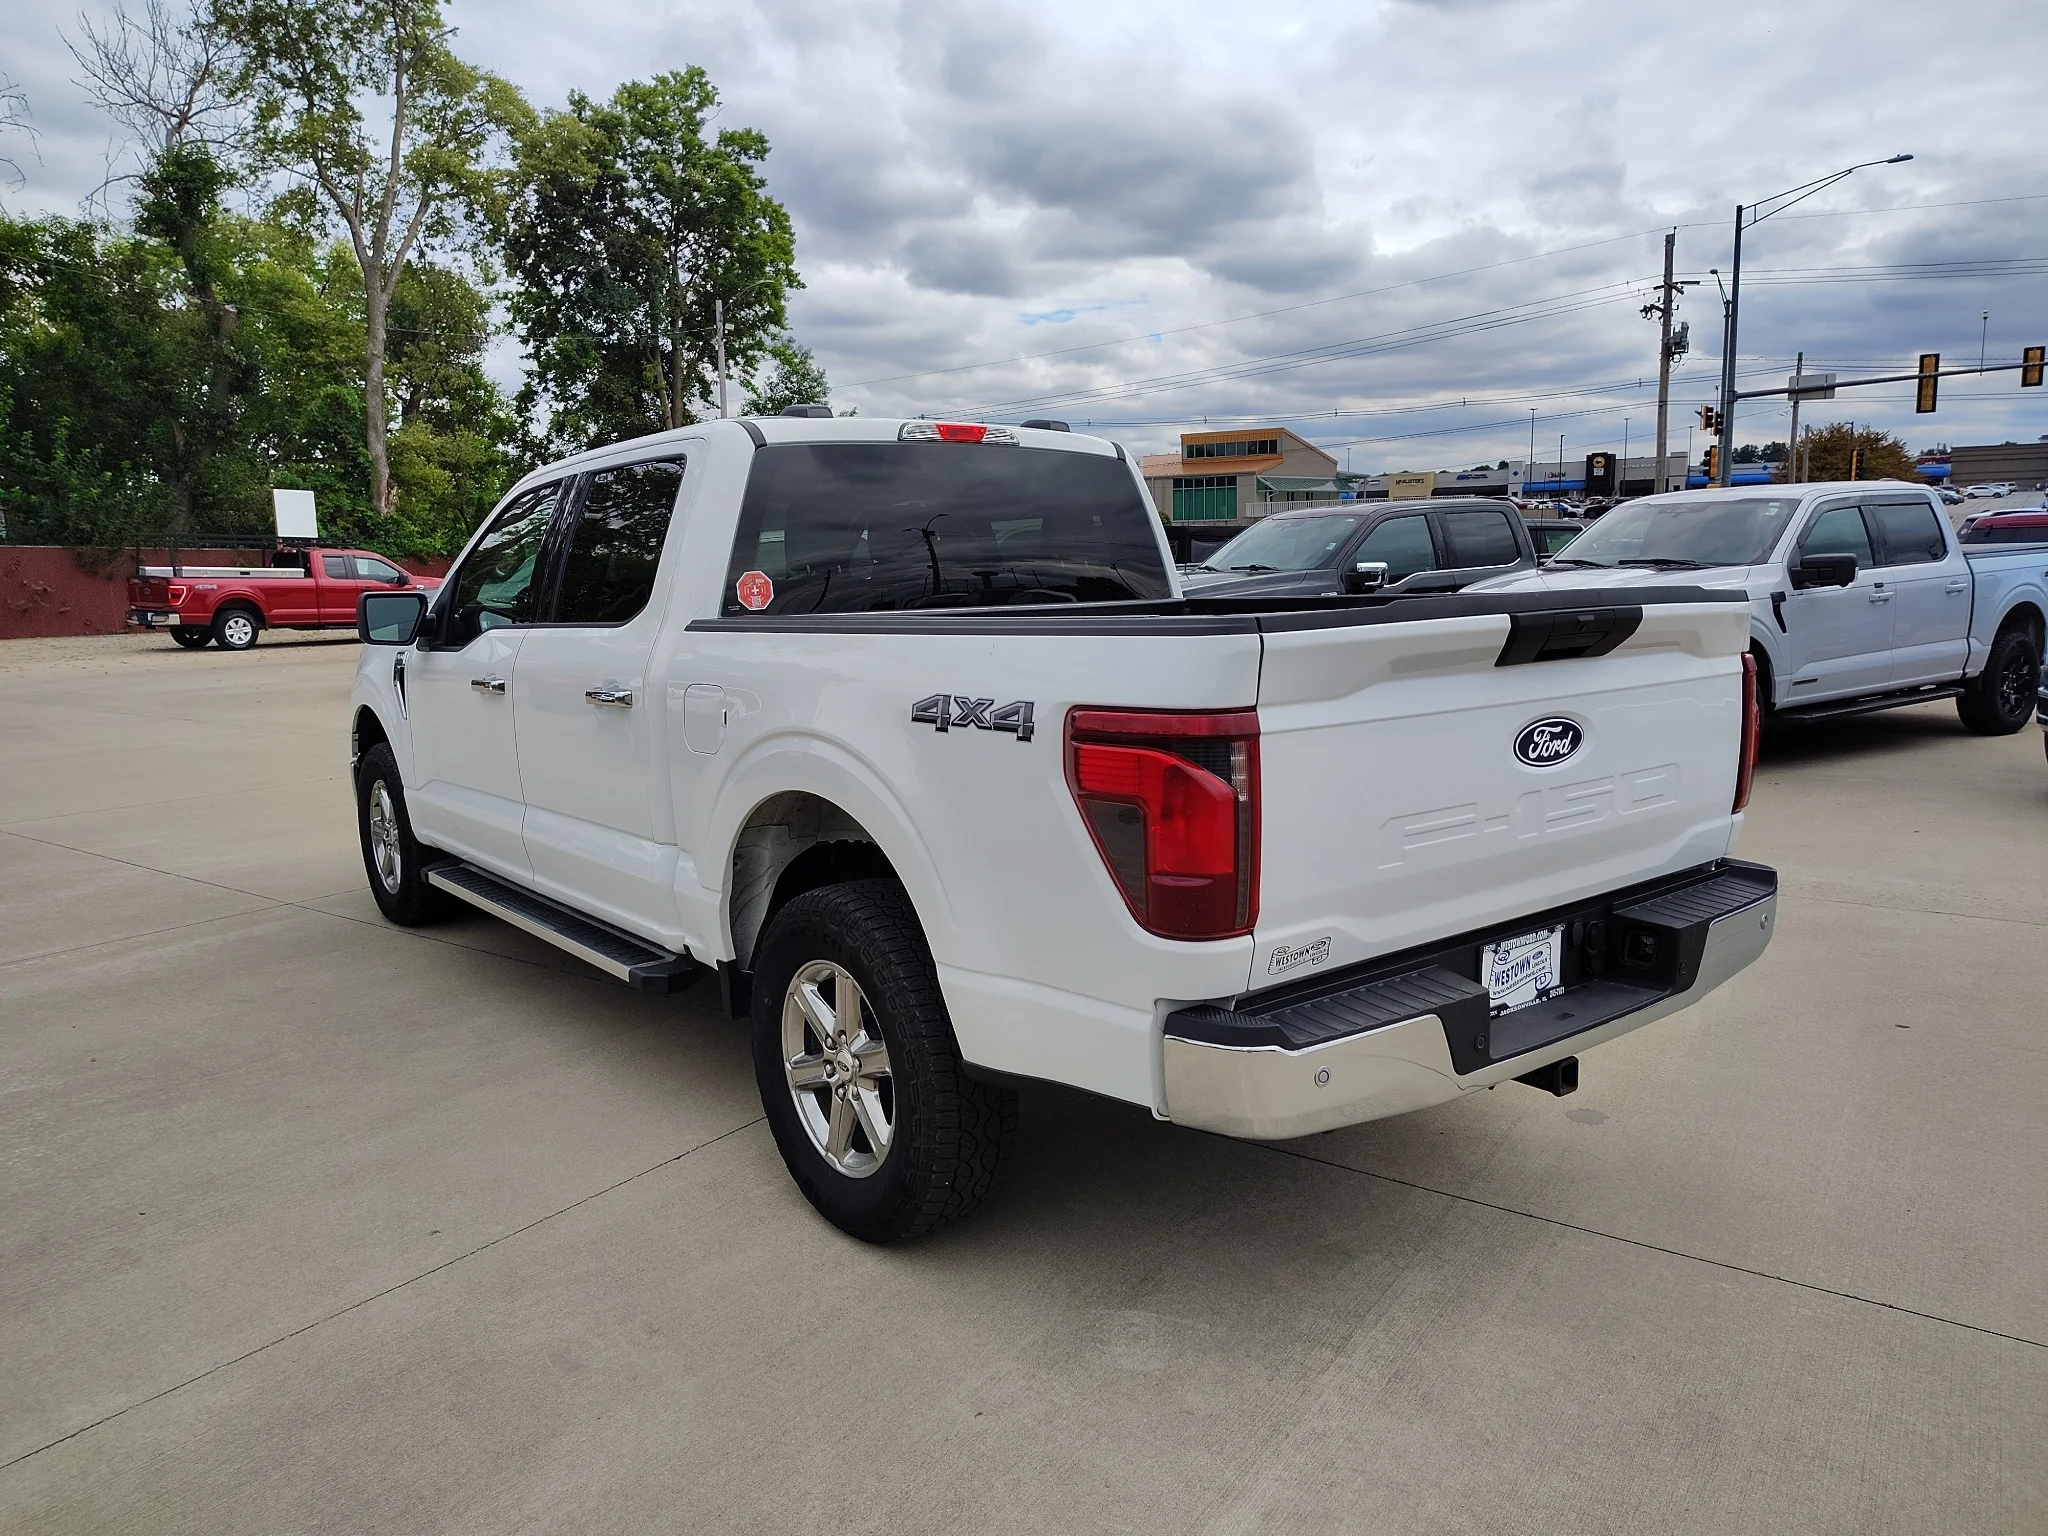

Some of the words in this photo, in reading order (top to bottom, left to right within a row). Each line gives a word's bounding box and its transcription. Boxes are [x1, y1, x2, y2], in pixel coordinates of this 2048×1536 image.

[1528, 725, 1574, 760] Ford
[1377, 762, 1681, 870] F-150
[1275, 946, 1311, 968] WESTOWN
[1494, 955, 1532, 988] WESTOWN
